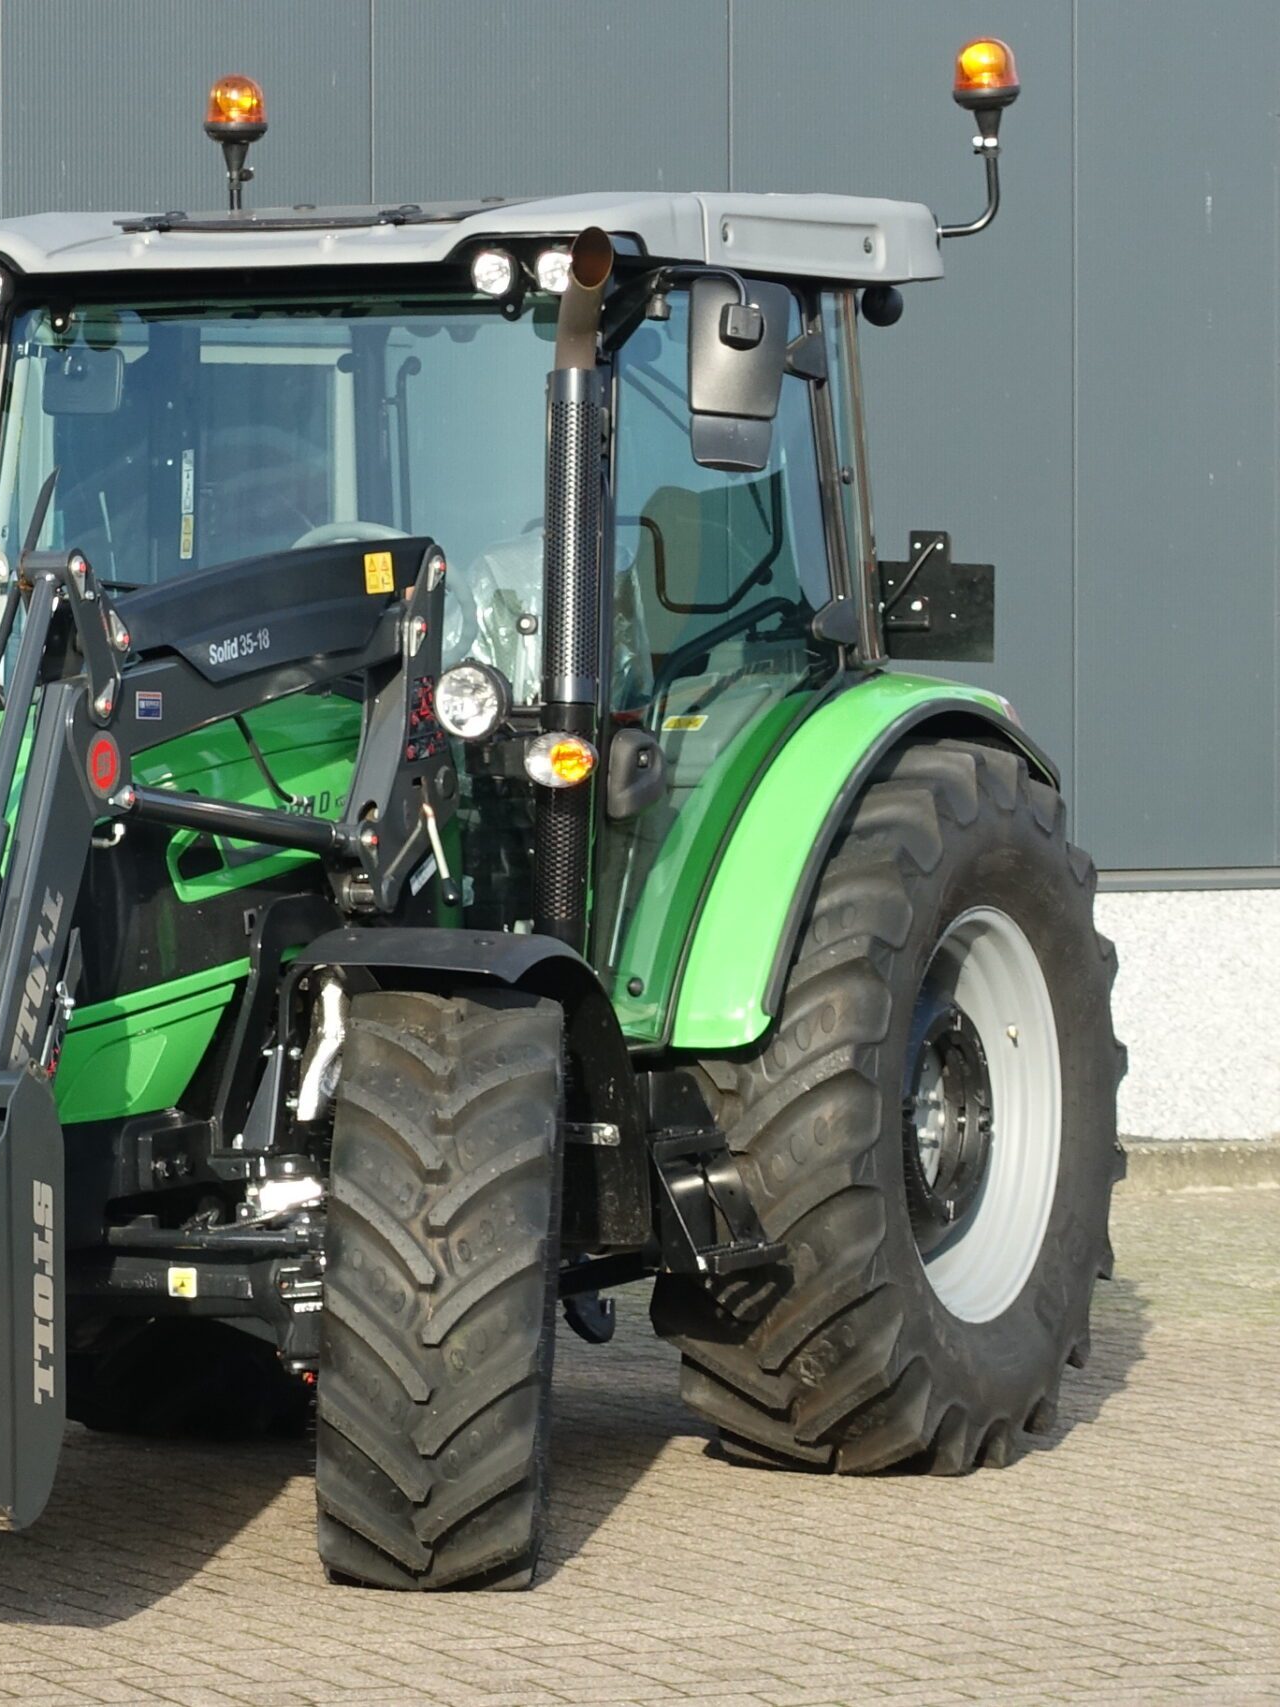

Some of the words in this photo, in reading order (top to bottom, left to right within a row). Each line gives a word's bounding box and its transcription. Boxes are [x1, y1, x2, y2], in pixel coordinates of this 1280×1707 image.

[209, 633, 239, 665] Solid
[240, 628, 270, 656] 35-18
[32, 1180, 54, 1404] STOLL
